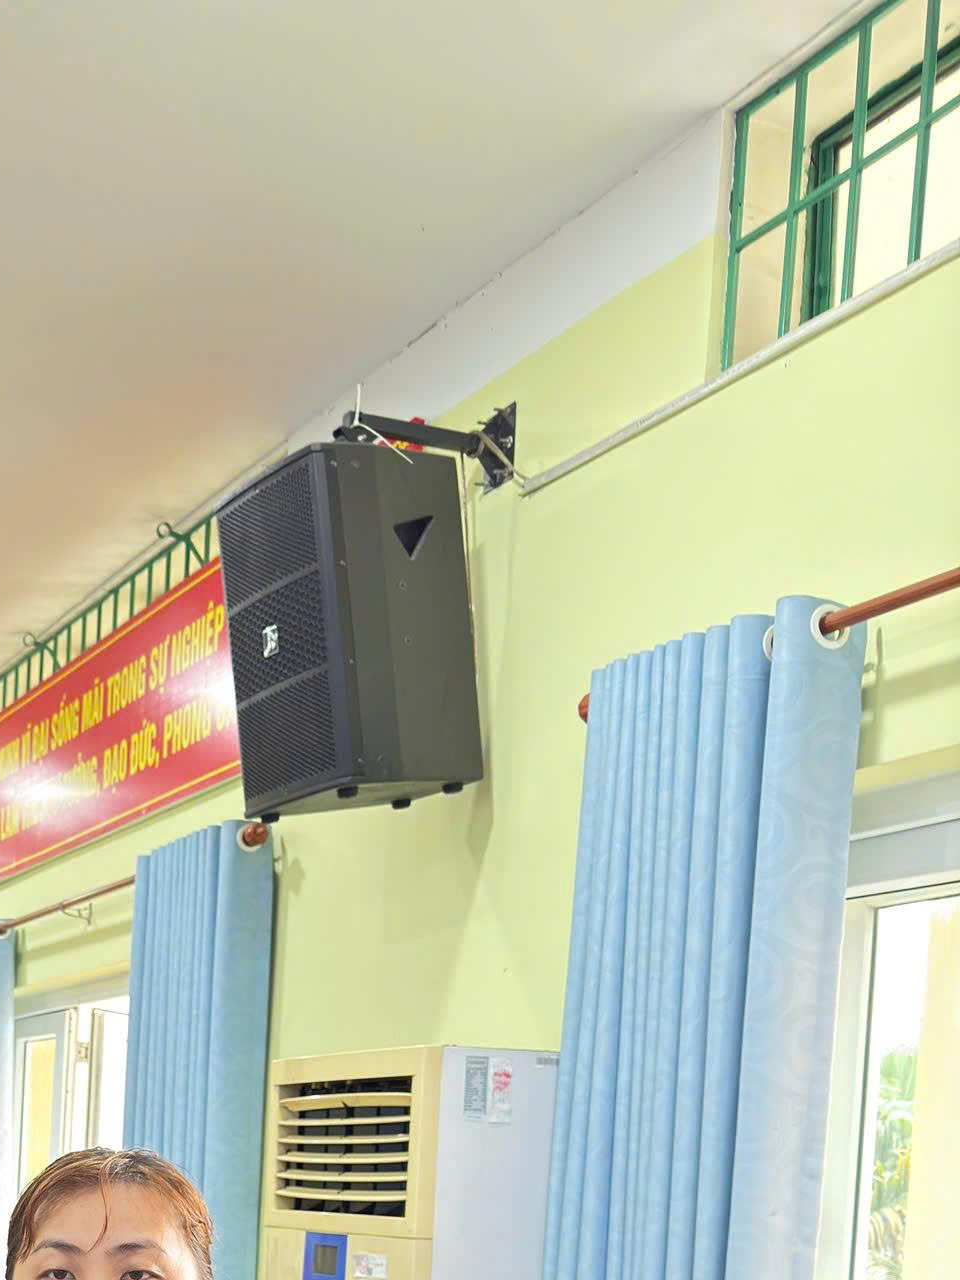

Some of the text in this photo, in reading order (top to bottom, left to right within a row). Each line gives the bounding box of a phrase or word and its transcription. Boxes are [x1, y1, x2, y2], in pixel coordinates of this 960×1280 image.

[106, 654, 147, 718] TRONG
[148, 634, 171, 694] SỰ
[170, 599, 226, 679] NGHIỆP
[103, 739, 127, 794] ĐẠO
[129, 718, 160, 775] ĐỨC,
[163, 700, 211, 759] PHONG
